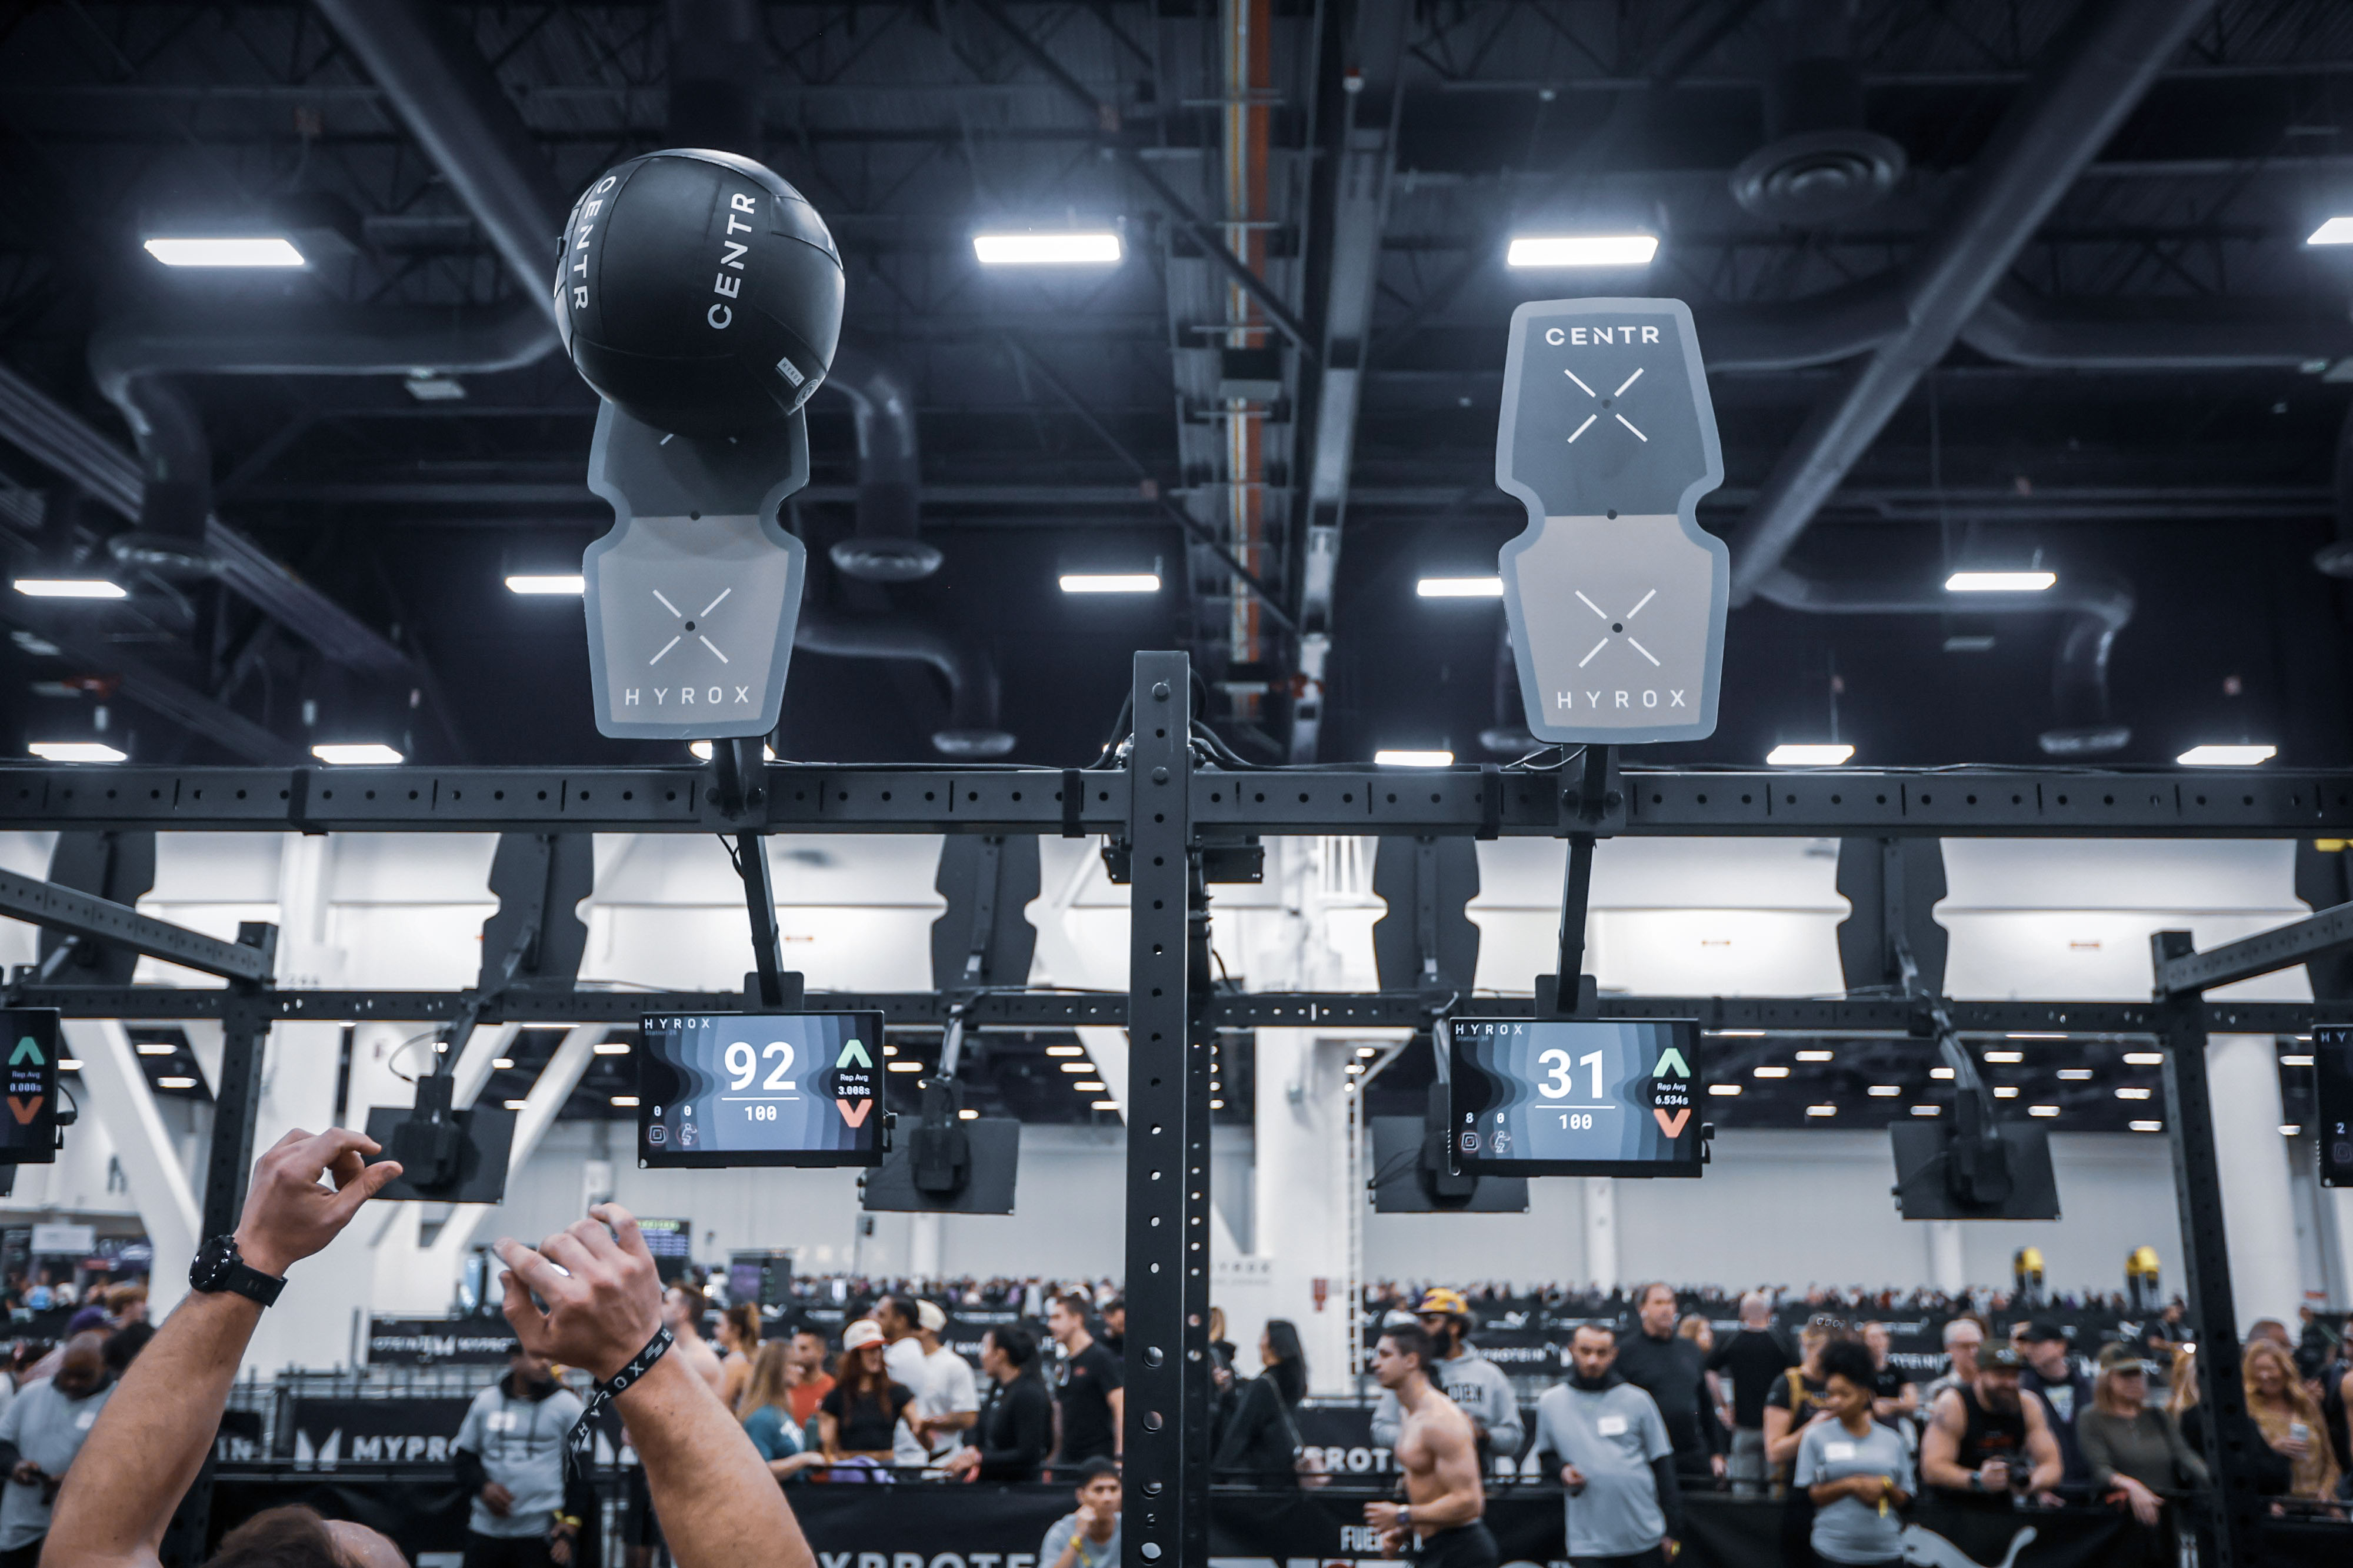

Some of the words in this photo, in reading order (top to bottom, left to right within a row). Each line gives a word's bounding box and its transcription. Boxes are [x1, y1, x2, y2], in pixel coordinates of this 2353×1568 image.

[574, 176, 616, 310] CENTR
[708, 193, 756, 329] CENTR
[1545, 326, 1659, 346] CENTR
[625, 686, 749, 705] HYROX
[1557, 689, 1685, 708] HYROX
[645, 1018, 709, 1029] HYROX
[1455, 1024, 1522, 1035] HYROX
[724, 1041, 796, 1090] 92
[27, 1071, 40, 1079] Avg
[840, 1073, 854, 1082] Rep
[855, 1073, 869, 1082] Avg
[1538, 1049, 1602, 1099] 31
[838, 1086, 871, 1095] 3.008s
[1657, 1082, 1671, 1092] Rep
[1672, 1082, 1687, 1092] Avg
[1655, 1095, 1688, 1105] 6.534s
[744, 1106, 777, 1121] 100
[1465, 1112, 1474, 1123] 8
[1497, 1112, 1504, 1123] 0
[1559, 1113, 1592, 1129] 100
[2336, 1122, 2345, 1134] 2
[354, 1436, 458, 1462] MYPR
